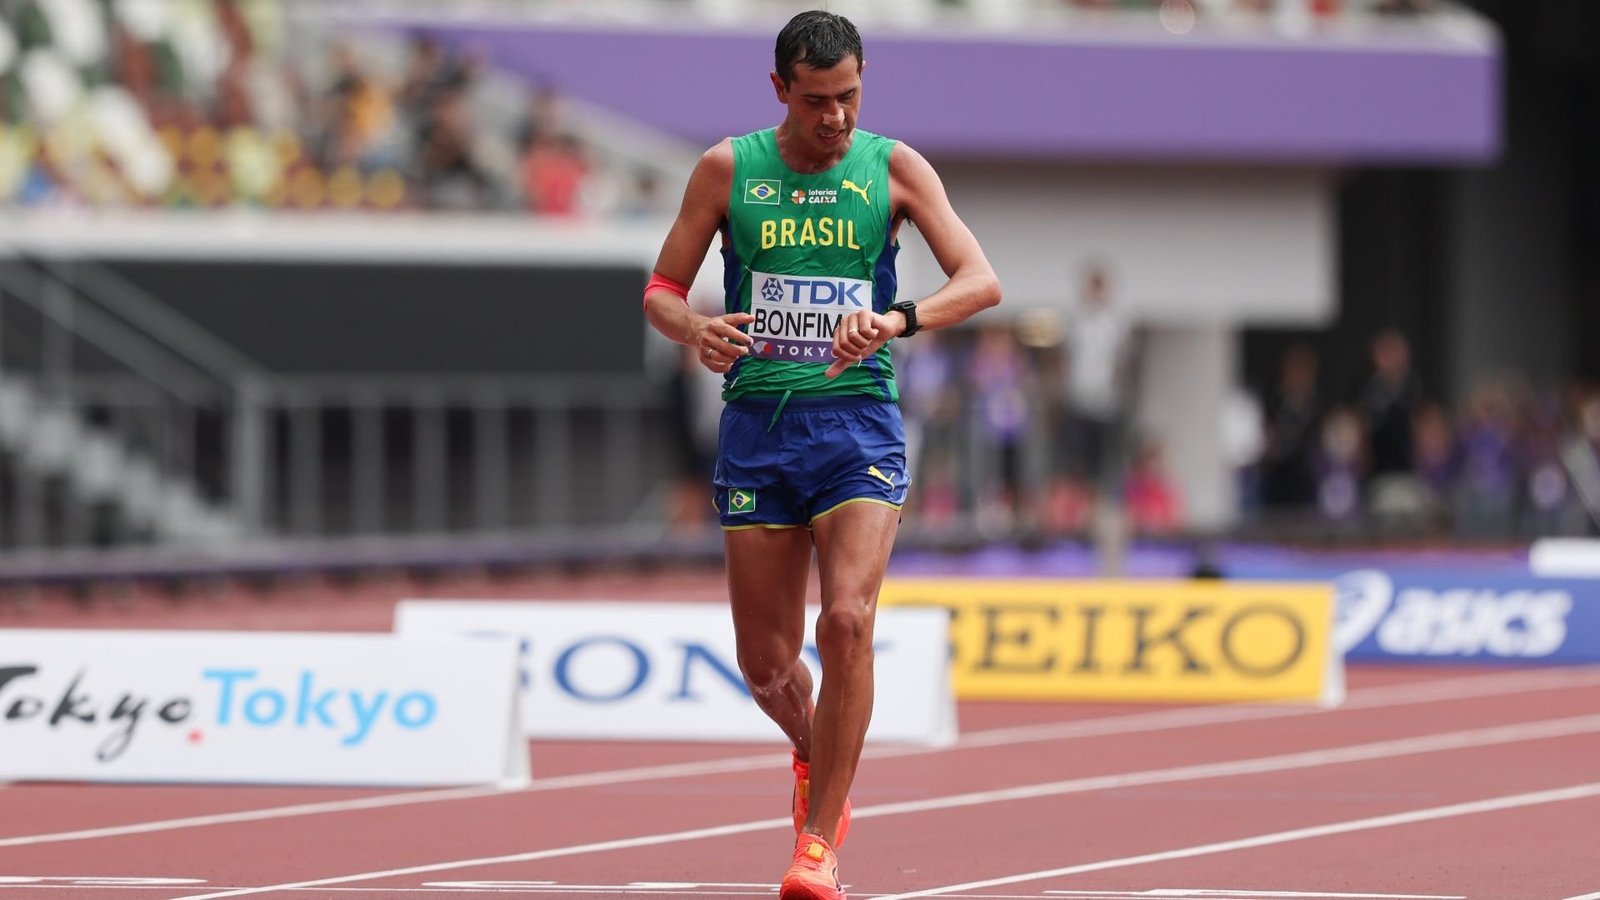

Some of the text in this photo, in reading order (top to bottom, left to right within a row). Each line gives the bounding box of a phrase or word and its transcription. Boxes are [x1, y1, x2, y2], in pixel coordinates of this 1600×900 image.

[808, 188, 837, 196] loterias
[808, 196, 837, 204] CAIXA
[761, 217, 860, 250] BRASIL
[784, 279, 863, 307] TDK
[1376, 587, 1573, 657] asics
[948, 601, 1307, 680] EIKO
[203, 668, 438, 746] Tokyo
